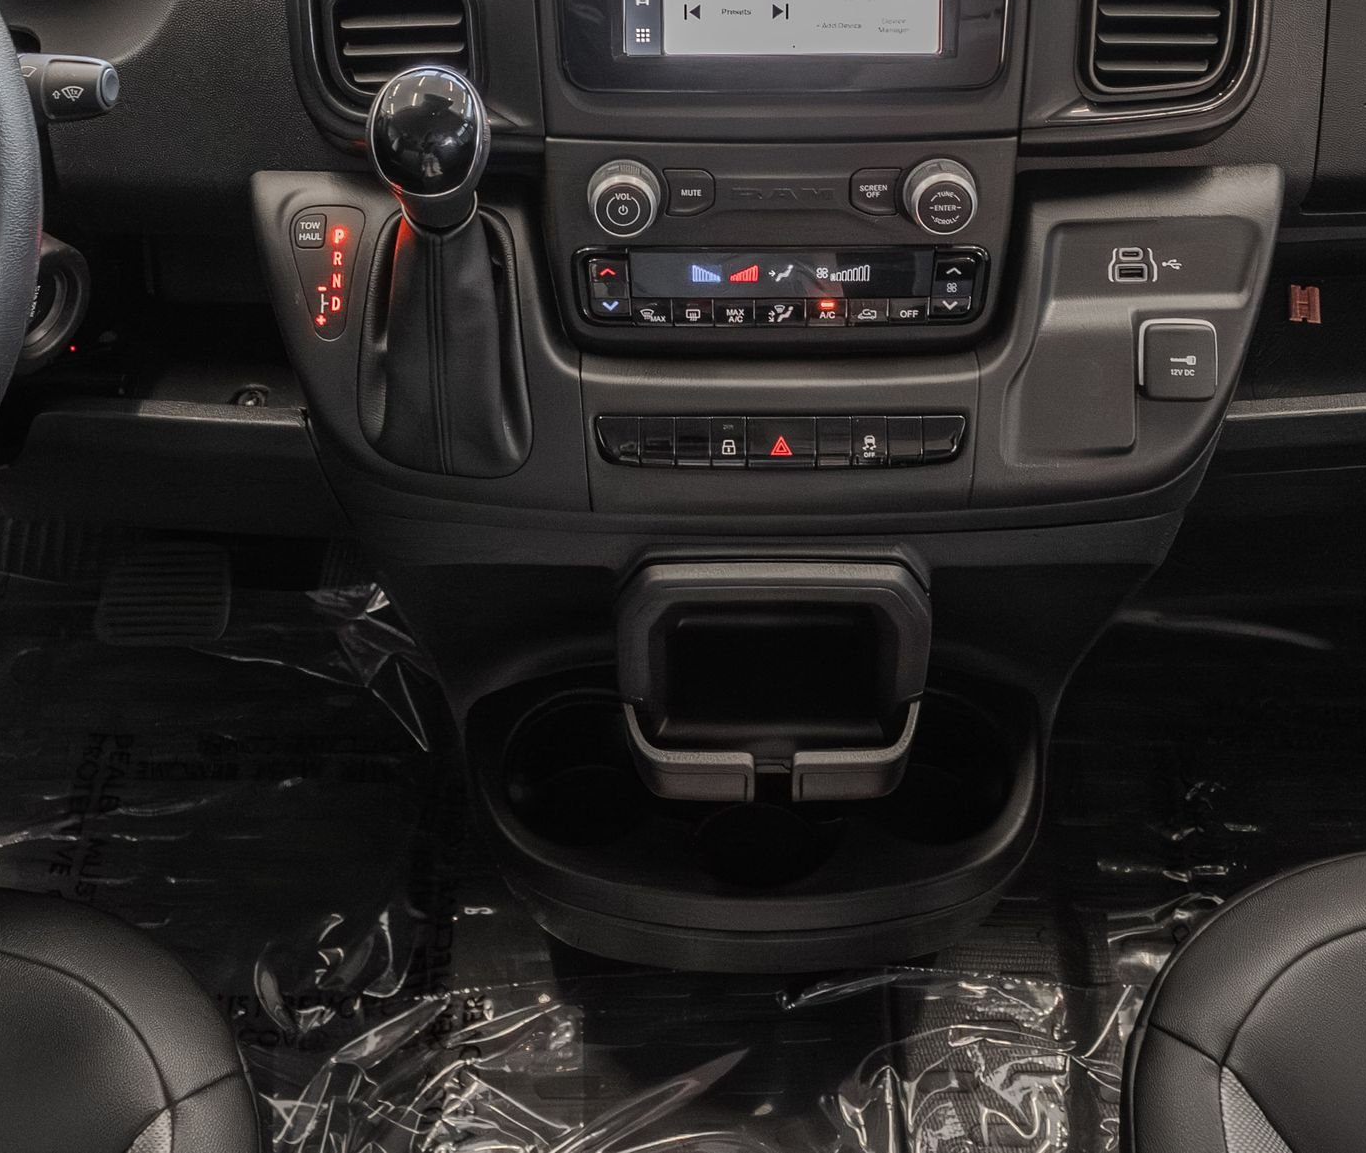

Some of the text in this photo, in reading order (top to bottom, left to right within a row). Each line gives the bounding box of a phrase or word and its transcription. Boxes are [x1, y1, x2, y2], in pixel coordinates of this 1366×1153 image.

[721, 8, 752, 16] Presets
[859, 184, 888, 192] SCREEN
[615, 193, 632, 201] VOL
[934, 204, 957, 212] ENTER
[934, 217, 957, 225] SCROLL
[300, 222, 320, 230] TOW
[299, 232, 322, 240] HAUL
[335, 228, 345, 244] P
[333, 252, 343, 266] R
[333, 274, 341, 288] N
[331, 296, 341, 311] D
[726, 308, 745, 316] MAX
[899, 310, 919, 318] OFF
[1171, 368, 1195, 376] 12V DC
